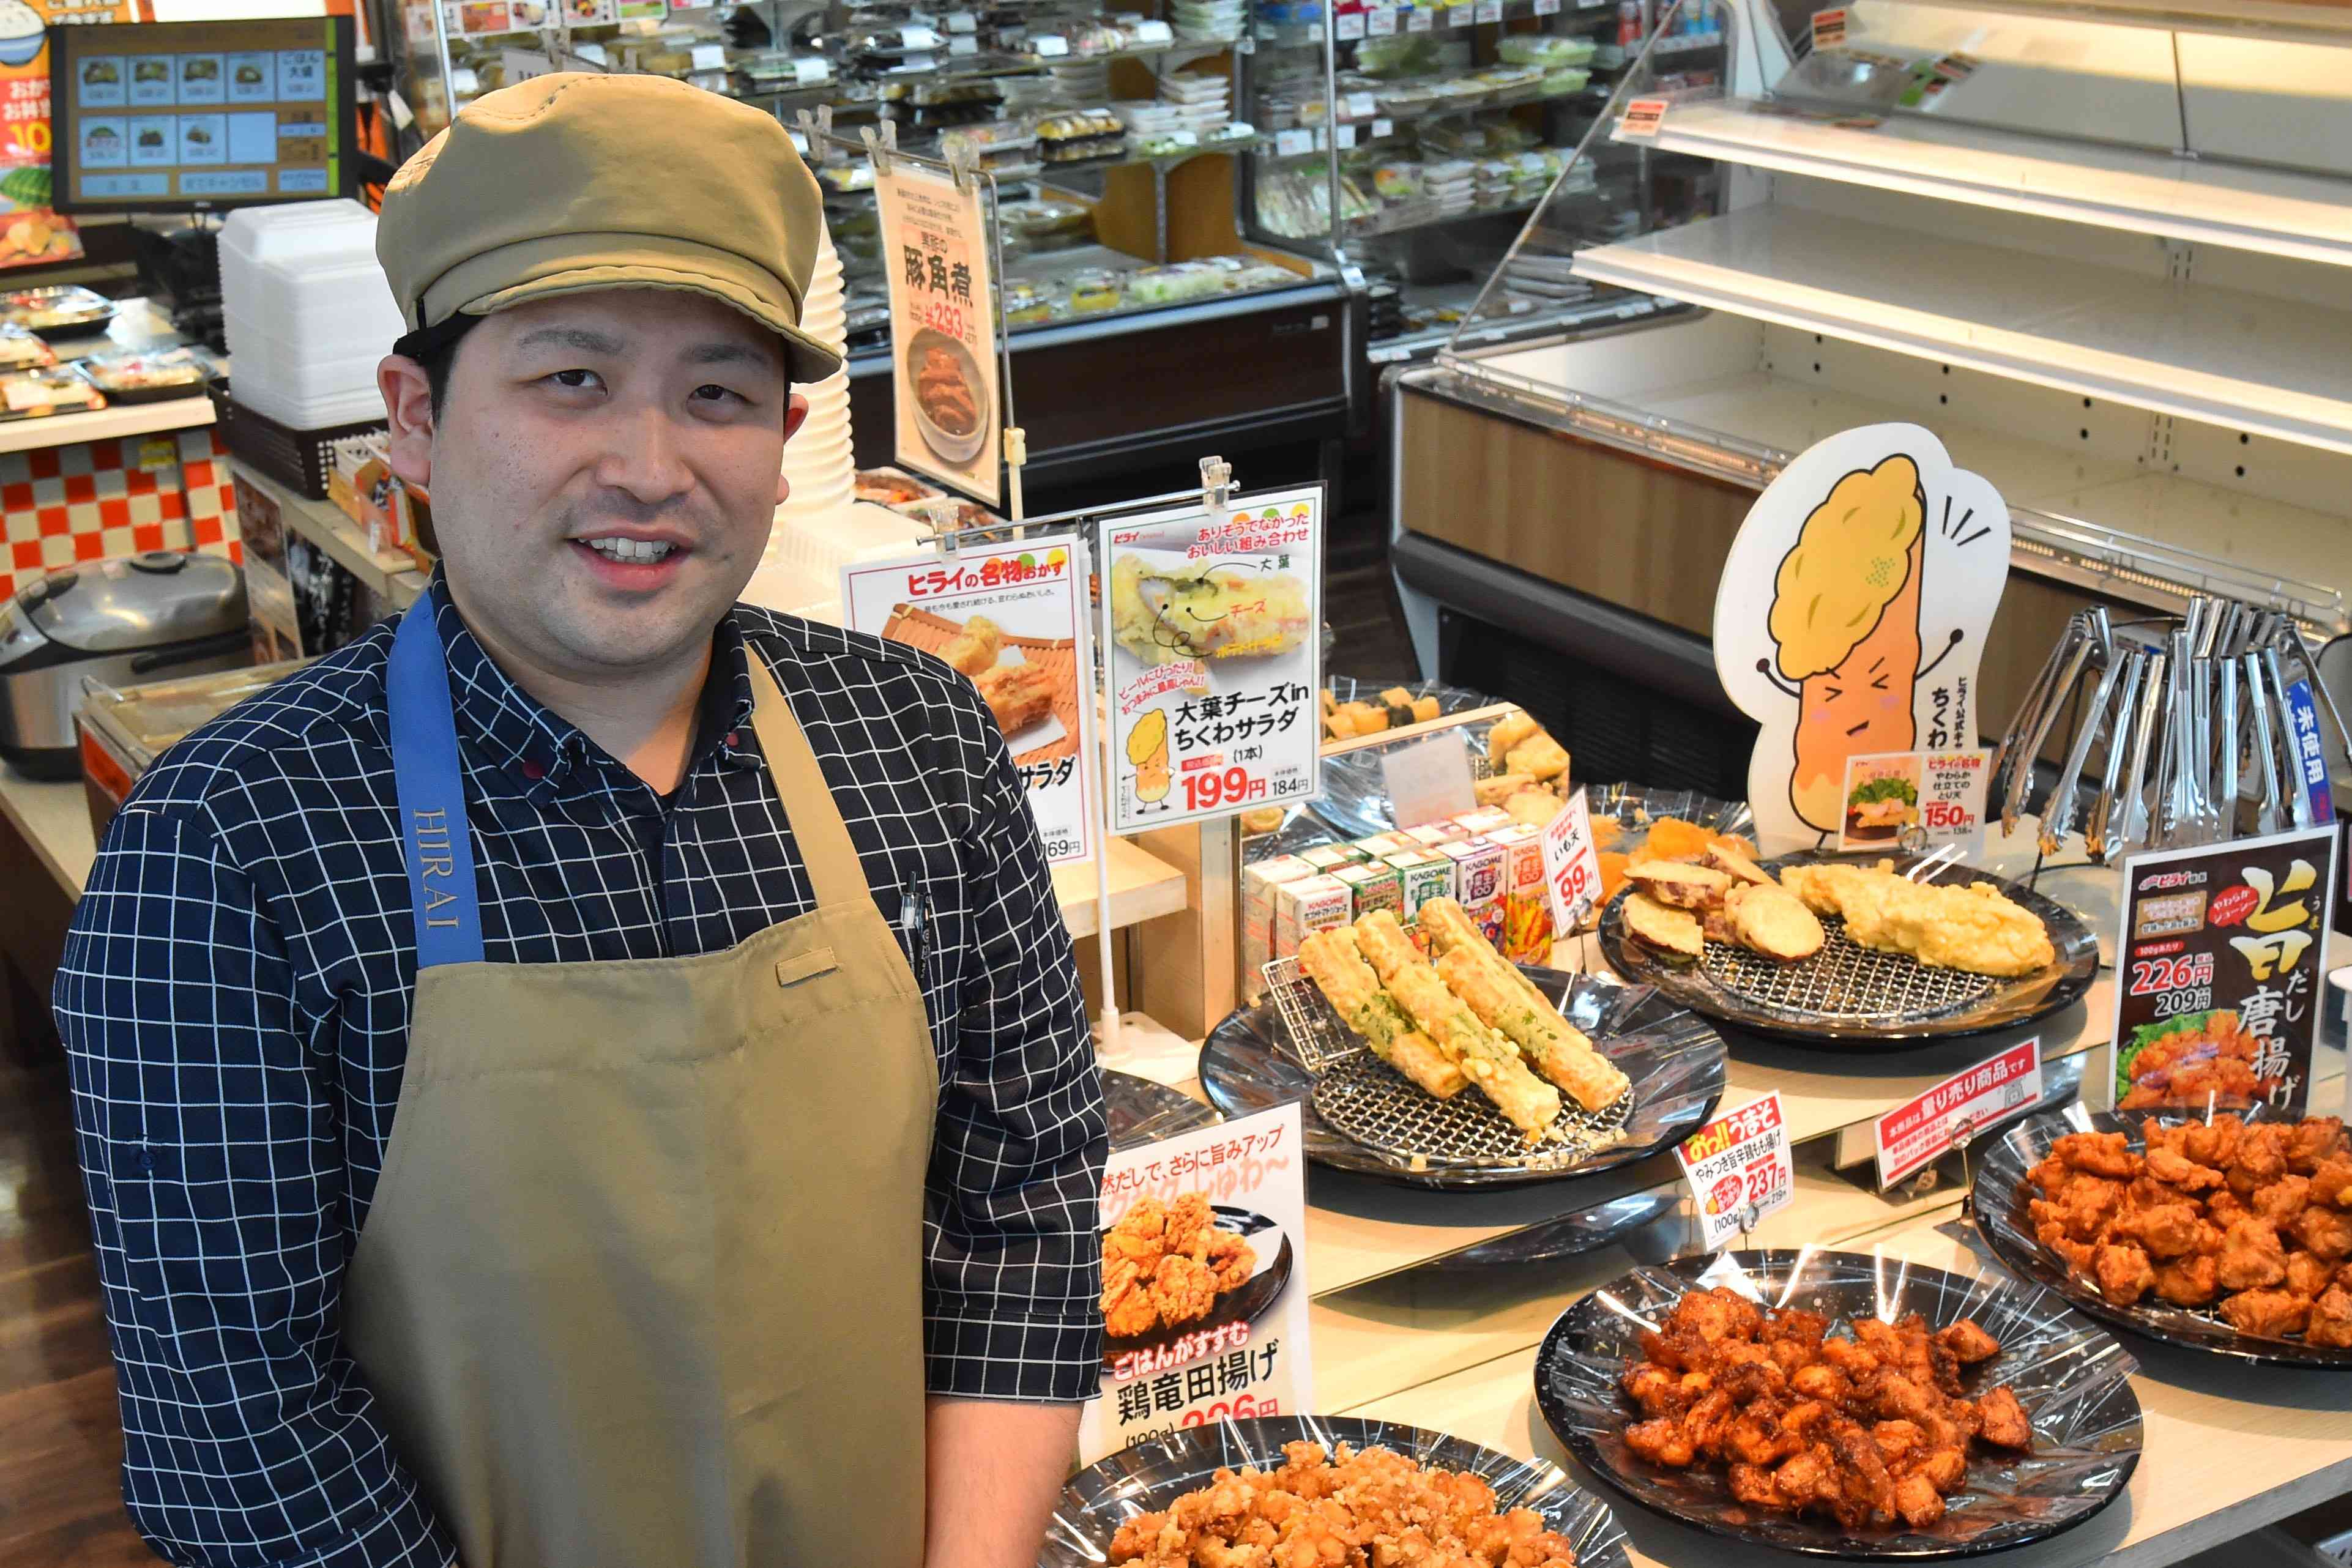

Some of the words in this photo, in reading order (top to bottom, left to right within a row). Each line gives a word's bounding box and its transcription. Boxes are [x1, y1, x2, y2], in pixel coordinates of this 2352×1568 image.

[903, 244, 973, 308] 豚角煮
[1187, 528, 1309, 559] おいしい組み合わせ
[1198, 513, 1309, 542] ありそうでなかった
[907, 559, 1065, 596] ヒライの名物おかず
[1230, 598, 1267, 618] チーズ
[1175, 682, 1310, 726] 大葉チーズin
[1927, 686, 1950, 749] ちくわ
[1174, 707, 1299, 751] ちくわサラダ
[1018, 756, 1076, 791] サラダ
[1233, 745, 1263, 764] (1本)
[1181, 766, 1266, 811] 199円
[1272, 777, 1309, 796] 184円
[1924, 806, 1975, 828] 150円
[413, 807, 460, 930] HIRAI
[1410, 866, 1452, 882] KAGOME
[1465, 855, 1503, 871] KAGOME
[2213, 890, 2251, 911] やわらか
[2130, 955, 2214, 995] 226円
[2154, 989, 2211, 1017] 209円
[2236, 985, 2301, 1112] 唐揚げ
[1695, 1128, 1781, 1183] やみつき旨辛鶏もも揚げ
[1746, 1162, 1787, 1202] 237円
[1113, 1320, 1249, 1382] ごはんがすすむ
[1117, 1338, 1279, 1427] 鶏竜田揚げ
